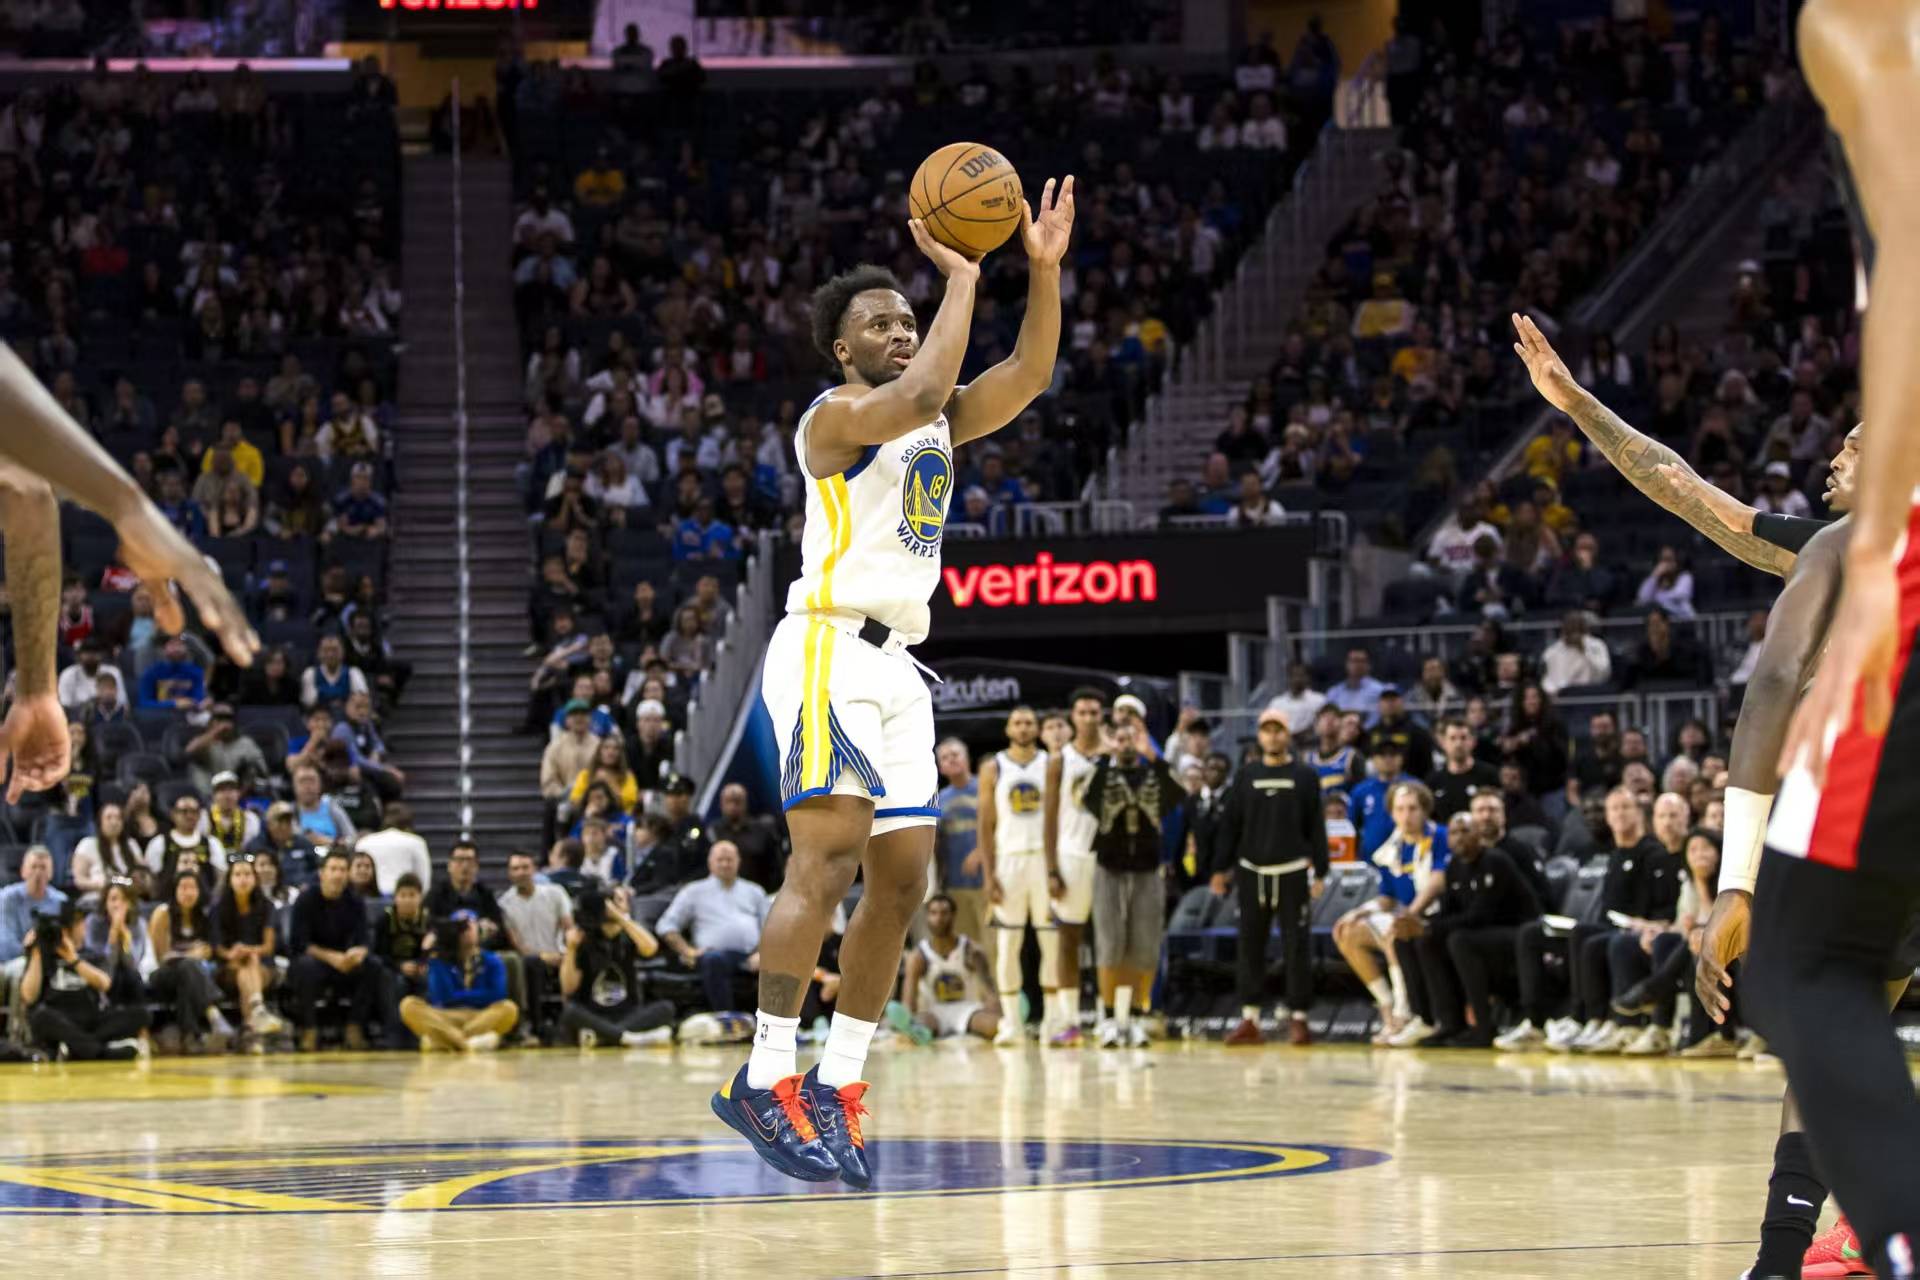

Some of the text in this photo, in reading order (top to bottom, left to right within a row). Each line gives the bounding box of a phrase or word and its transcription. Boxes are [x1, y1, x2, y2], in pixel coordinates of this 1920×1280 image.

[900, 437, 939, 463] GOLDEN
[929, 474, 945, 499] 18
[943, 551, 1157, 607] verizon
[930, 676, 1020, 702] akuten
